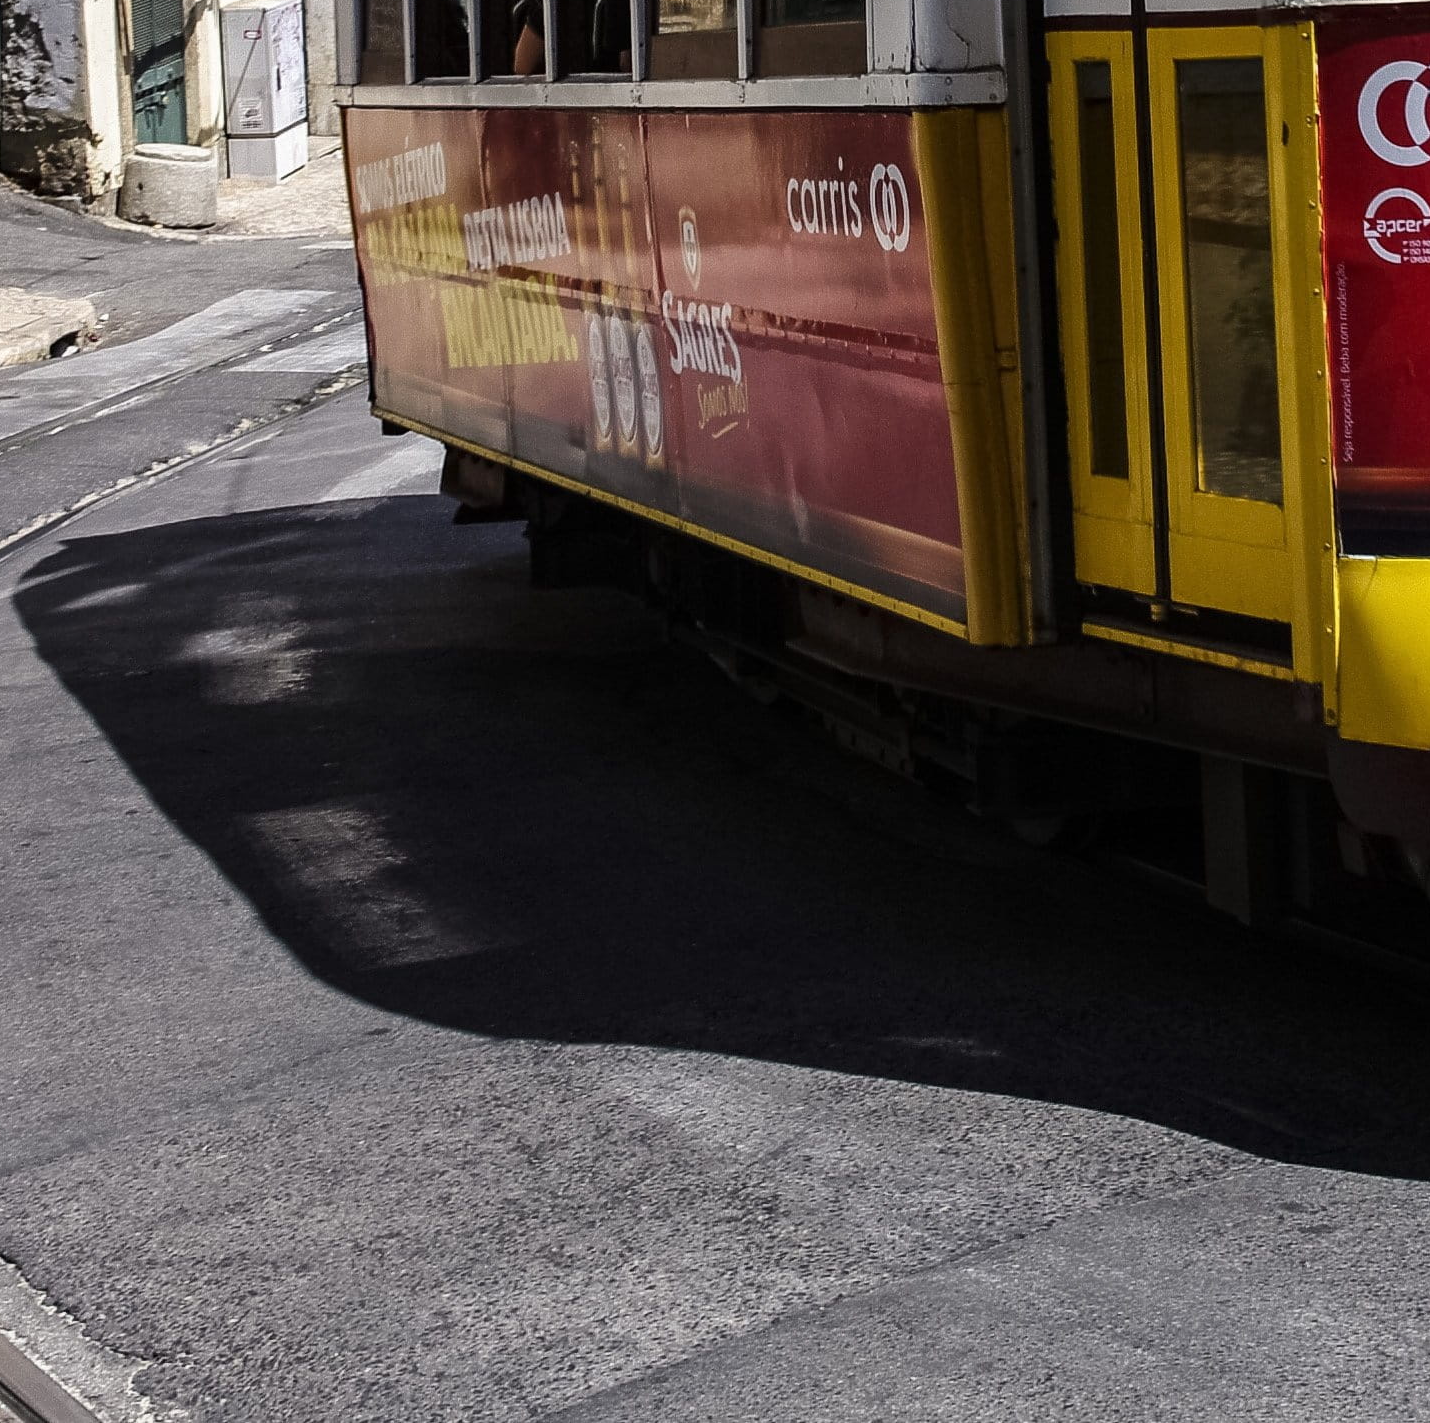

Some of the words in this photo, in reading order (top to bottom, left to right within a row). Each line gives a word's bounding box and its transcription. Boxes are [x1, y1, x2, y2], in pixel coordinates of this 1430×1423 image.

[787, 156, 863, 239] carris
[464, 206, 513, 273] DESTA
[508, 191, 571, 264] LISBOA
[1376, 219, 1423, 237] apcer
[662, 290, 742, 385] SAGRES
[1340, 320, 1349, 344] com
[1340, 346, 1351, 374] Beba
